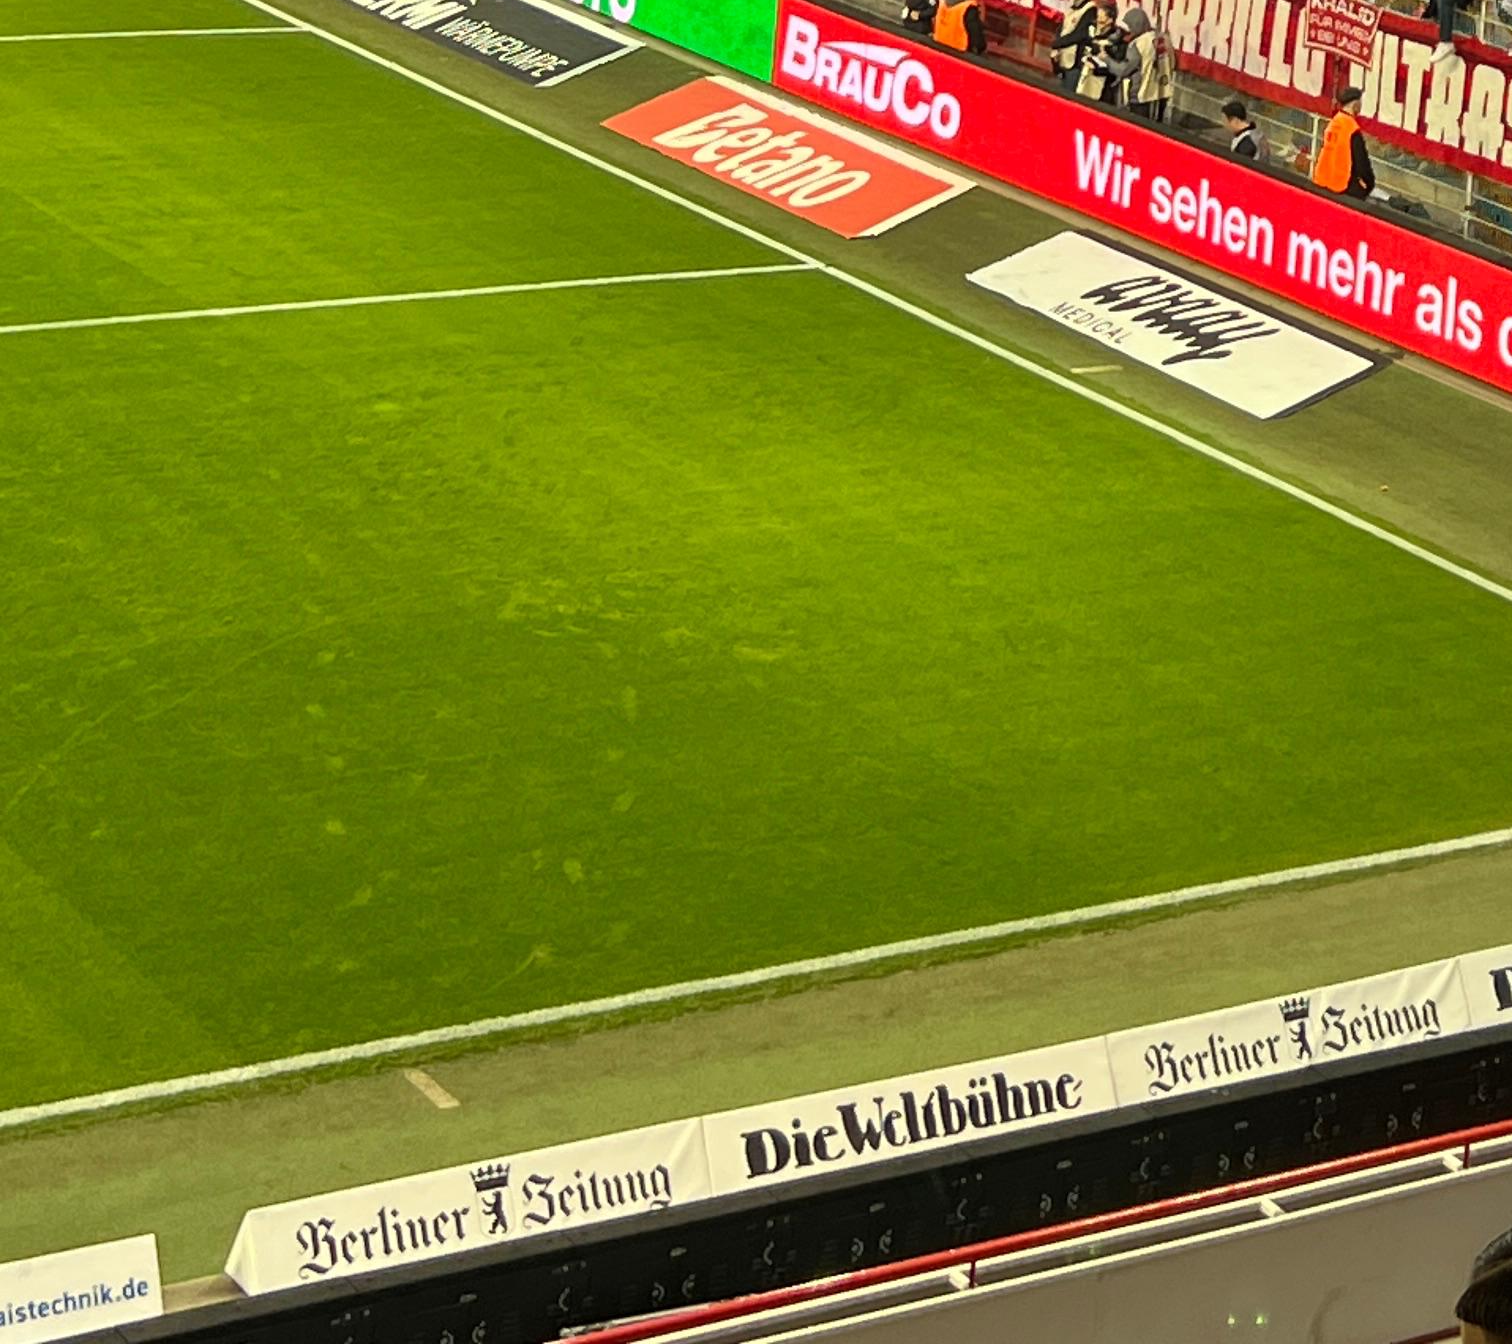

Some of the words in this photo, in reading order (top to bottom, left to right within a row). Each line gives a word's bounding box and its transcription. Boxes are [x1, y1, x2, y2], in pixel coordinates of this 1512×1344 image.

[652, 102, 872, 209] Betano
[1074, 128, 1141, 212] Wir
[1148, 173, 1275, 269] sehen
[1287, 232, 1407, 314] mehr
[1415, 283, 1485, 353] als
[1052, 301, 1133, 345] MEDICAL
[1144, 1031, 1282, 1095] Berliner
[1319, 995, 1442, 1053] Zeitung
[295, 1203, 470, 1280] Berliner
[522, 1162, 673, 1226] Zeitung
